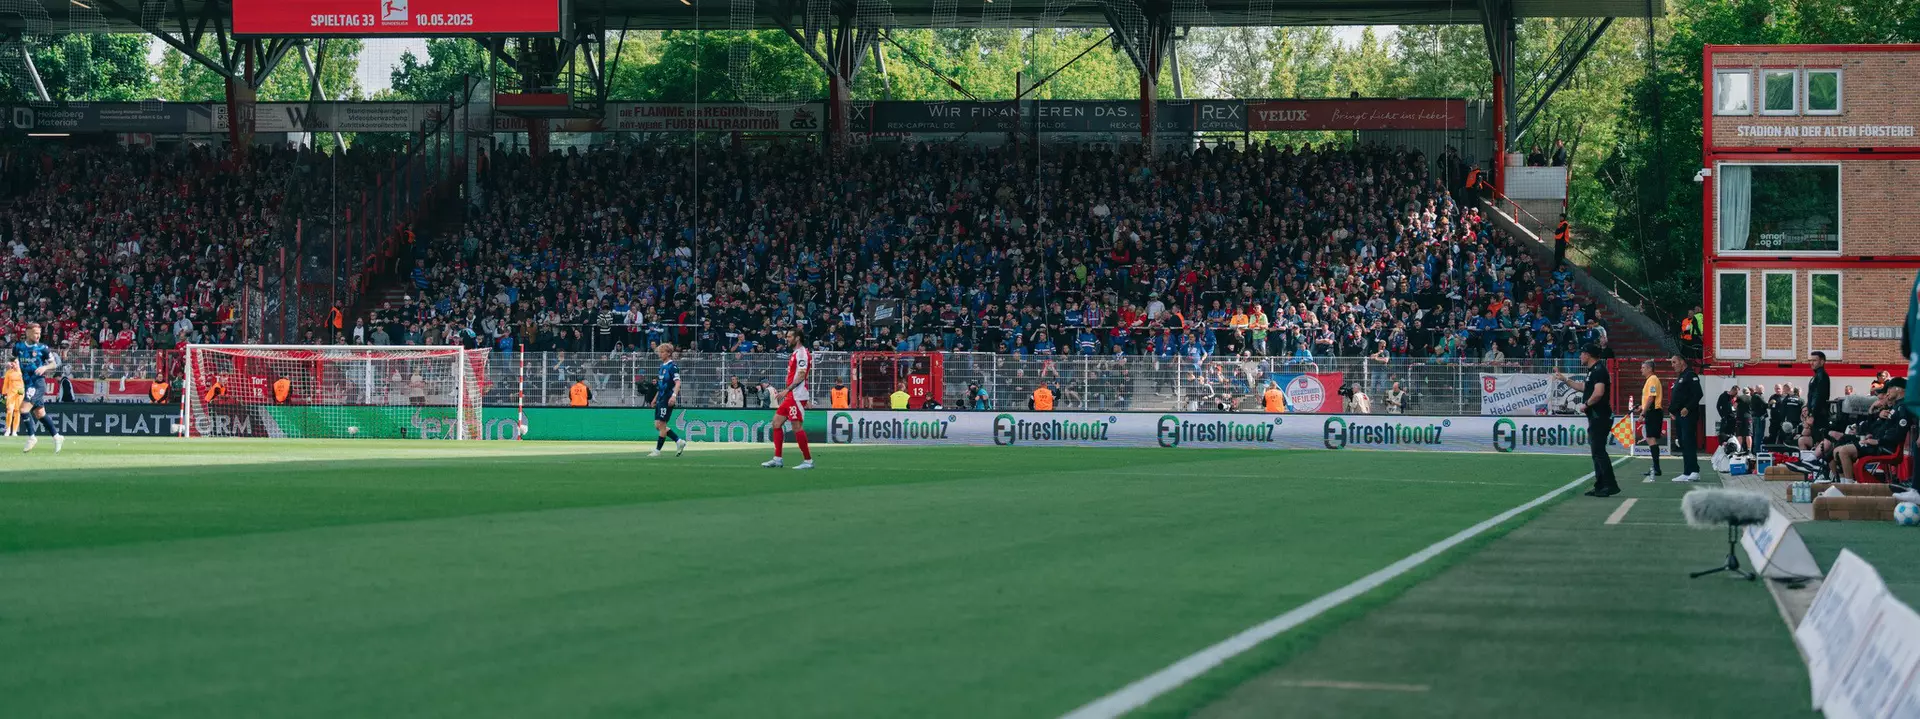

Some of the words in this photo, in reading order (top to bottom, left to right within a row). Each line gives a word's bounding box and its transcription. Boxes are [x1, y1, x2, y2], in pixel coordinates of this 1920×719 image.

[311, 14, 360, 26] SPIELTAG
[362, 14, 375, 26] 33
[416, 14, 473, 26] 10.05.2025
[37, 110, 84, 120] Heidelberg
[634, 107, 685, 118] FLAMME
[704, 107, 748, 117] REGION
[1202, 104, 1240, 119] REX
[1259, 110, 1307, 122] VELUX
[1331, 108, 1367, 126] Bringt
[37, 118, 78, 126] Materials
[1737, 126, 1781, 137] STADION
[1784, 126, 1798, 137] AN
[1801, 126, 1821, 137] DER
[1824, 126, 1856, 137] ALTEN
[1859, 125, 1914, 137] FÖRSTEREI
[251, 376, 264, 385] Tor
[911, 376, 925, 385] Tor
[253, 388, 262, 396] 12
[913, 388, 923, 397] 13
[1483, 378, 1548, 405] Fußballmania
[1291, 393, 1320, 404] NEULER
[1490, 393, 1547, 415] Heidenheim
[660, 408, 667, 416] 13
[858, 418, 948, 440] freshfoodz
[1018, 419, 1108, 442] freshfoodz
[1182, 420, 1274, 443] freshfoodz
[1348, 422, 1442, 445] freshfoodz
[1521, 424, 1617, 447] freshfoz
